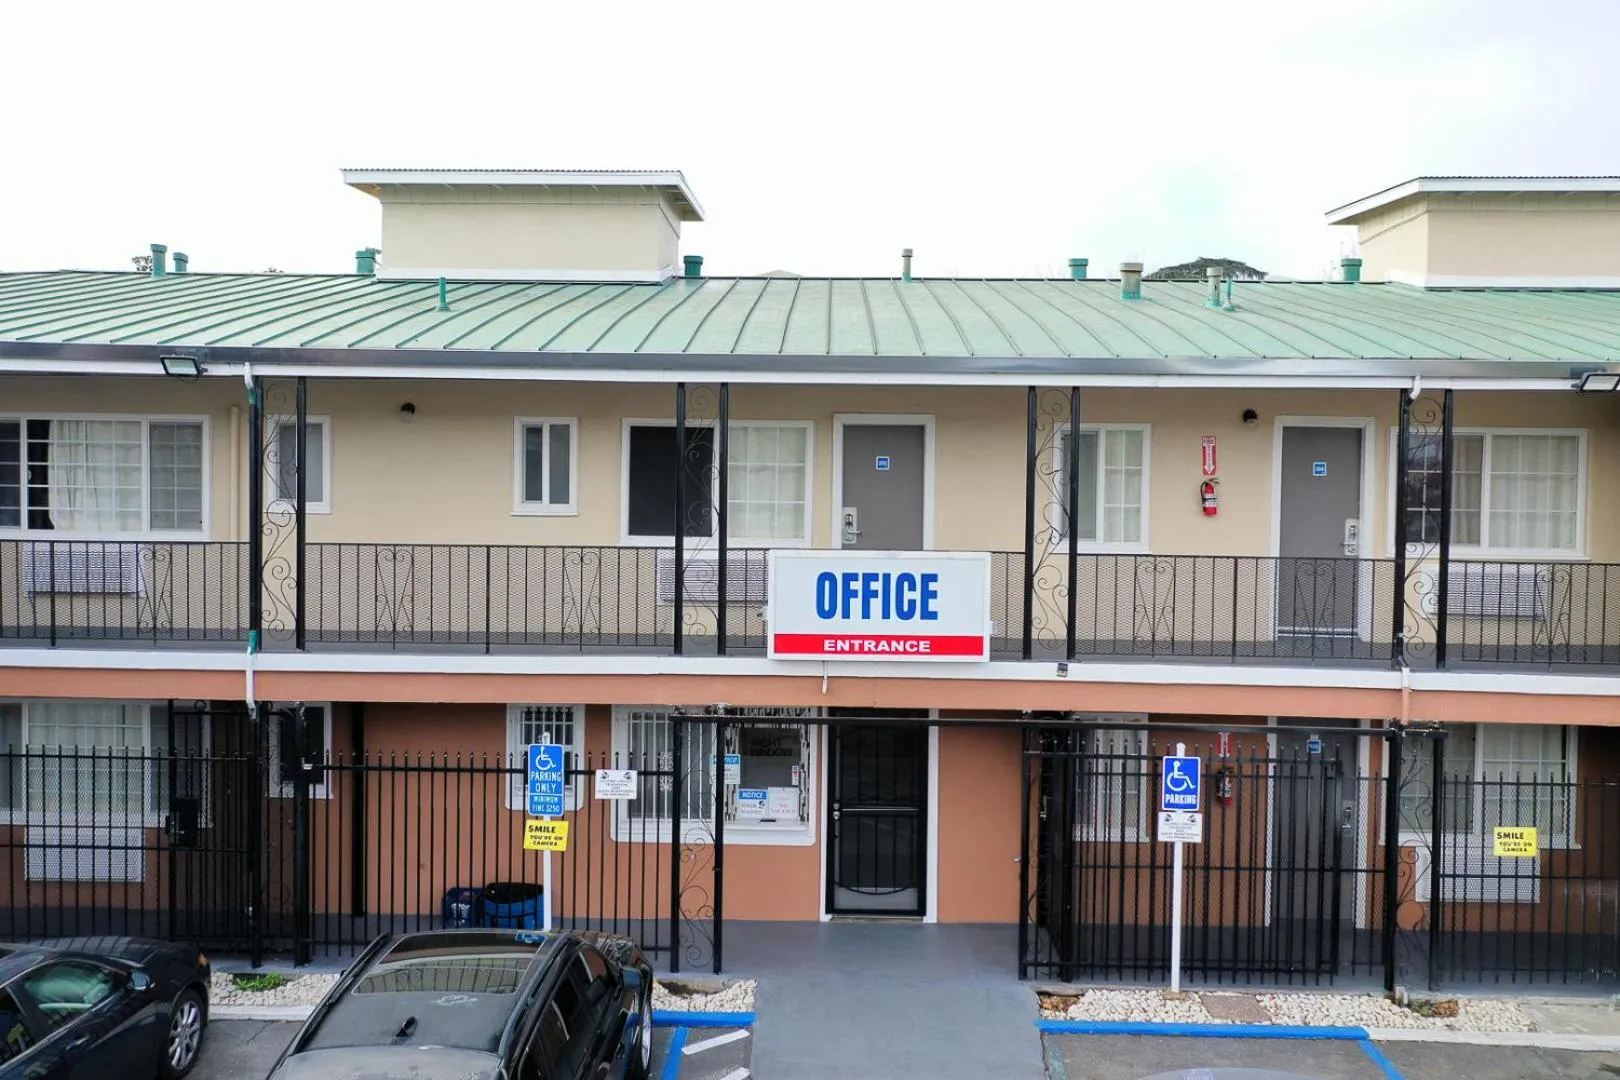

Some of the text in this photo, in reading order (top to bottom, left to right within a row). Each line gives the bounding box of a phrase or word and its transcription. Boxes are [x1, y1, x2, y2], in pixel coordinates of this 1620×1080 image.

[816, 571, 938, 620] OFFICE
[823, 639, 931, 653] ENTRANCE
[530, 771, 562, 782] PARKING
[535, 783, 557, 793] ONLY
[741, 791, 764, 799] NOTICE
[1166, 794, 1197, 804] PARKING
[532, 804, 545, 812] FINE
[529, 825, 556, 833] SMILE
